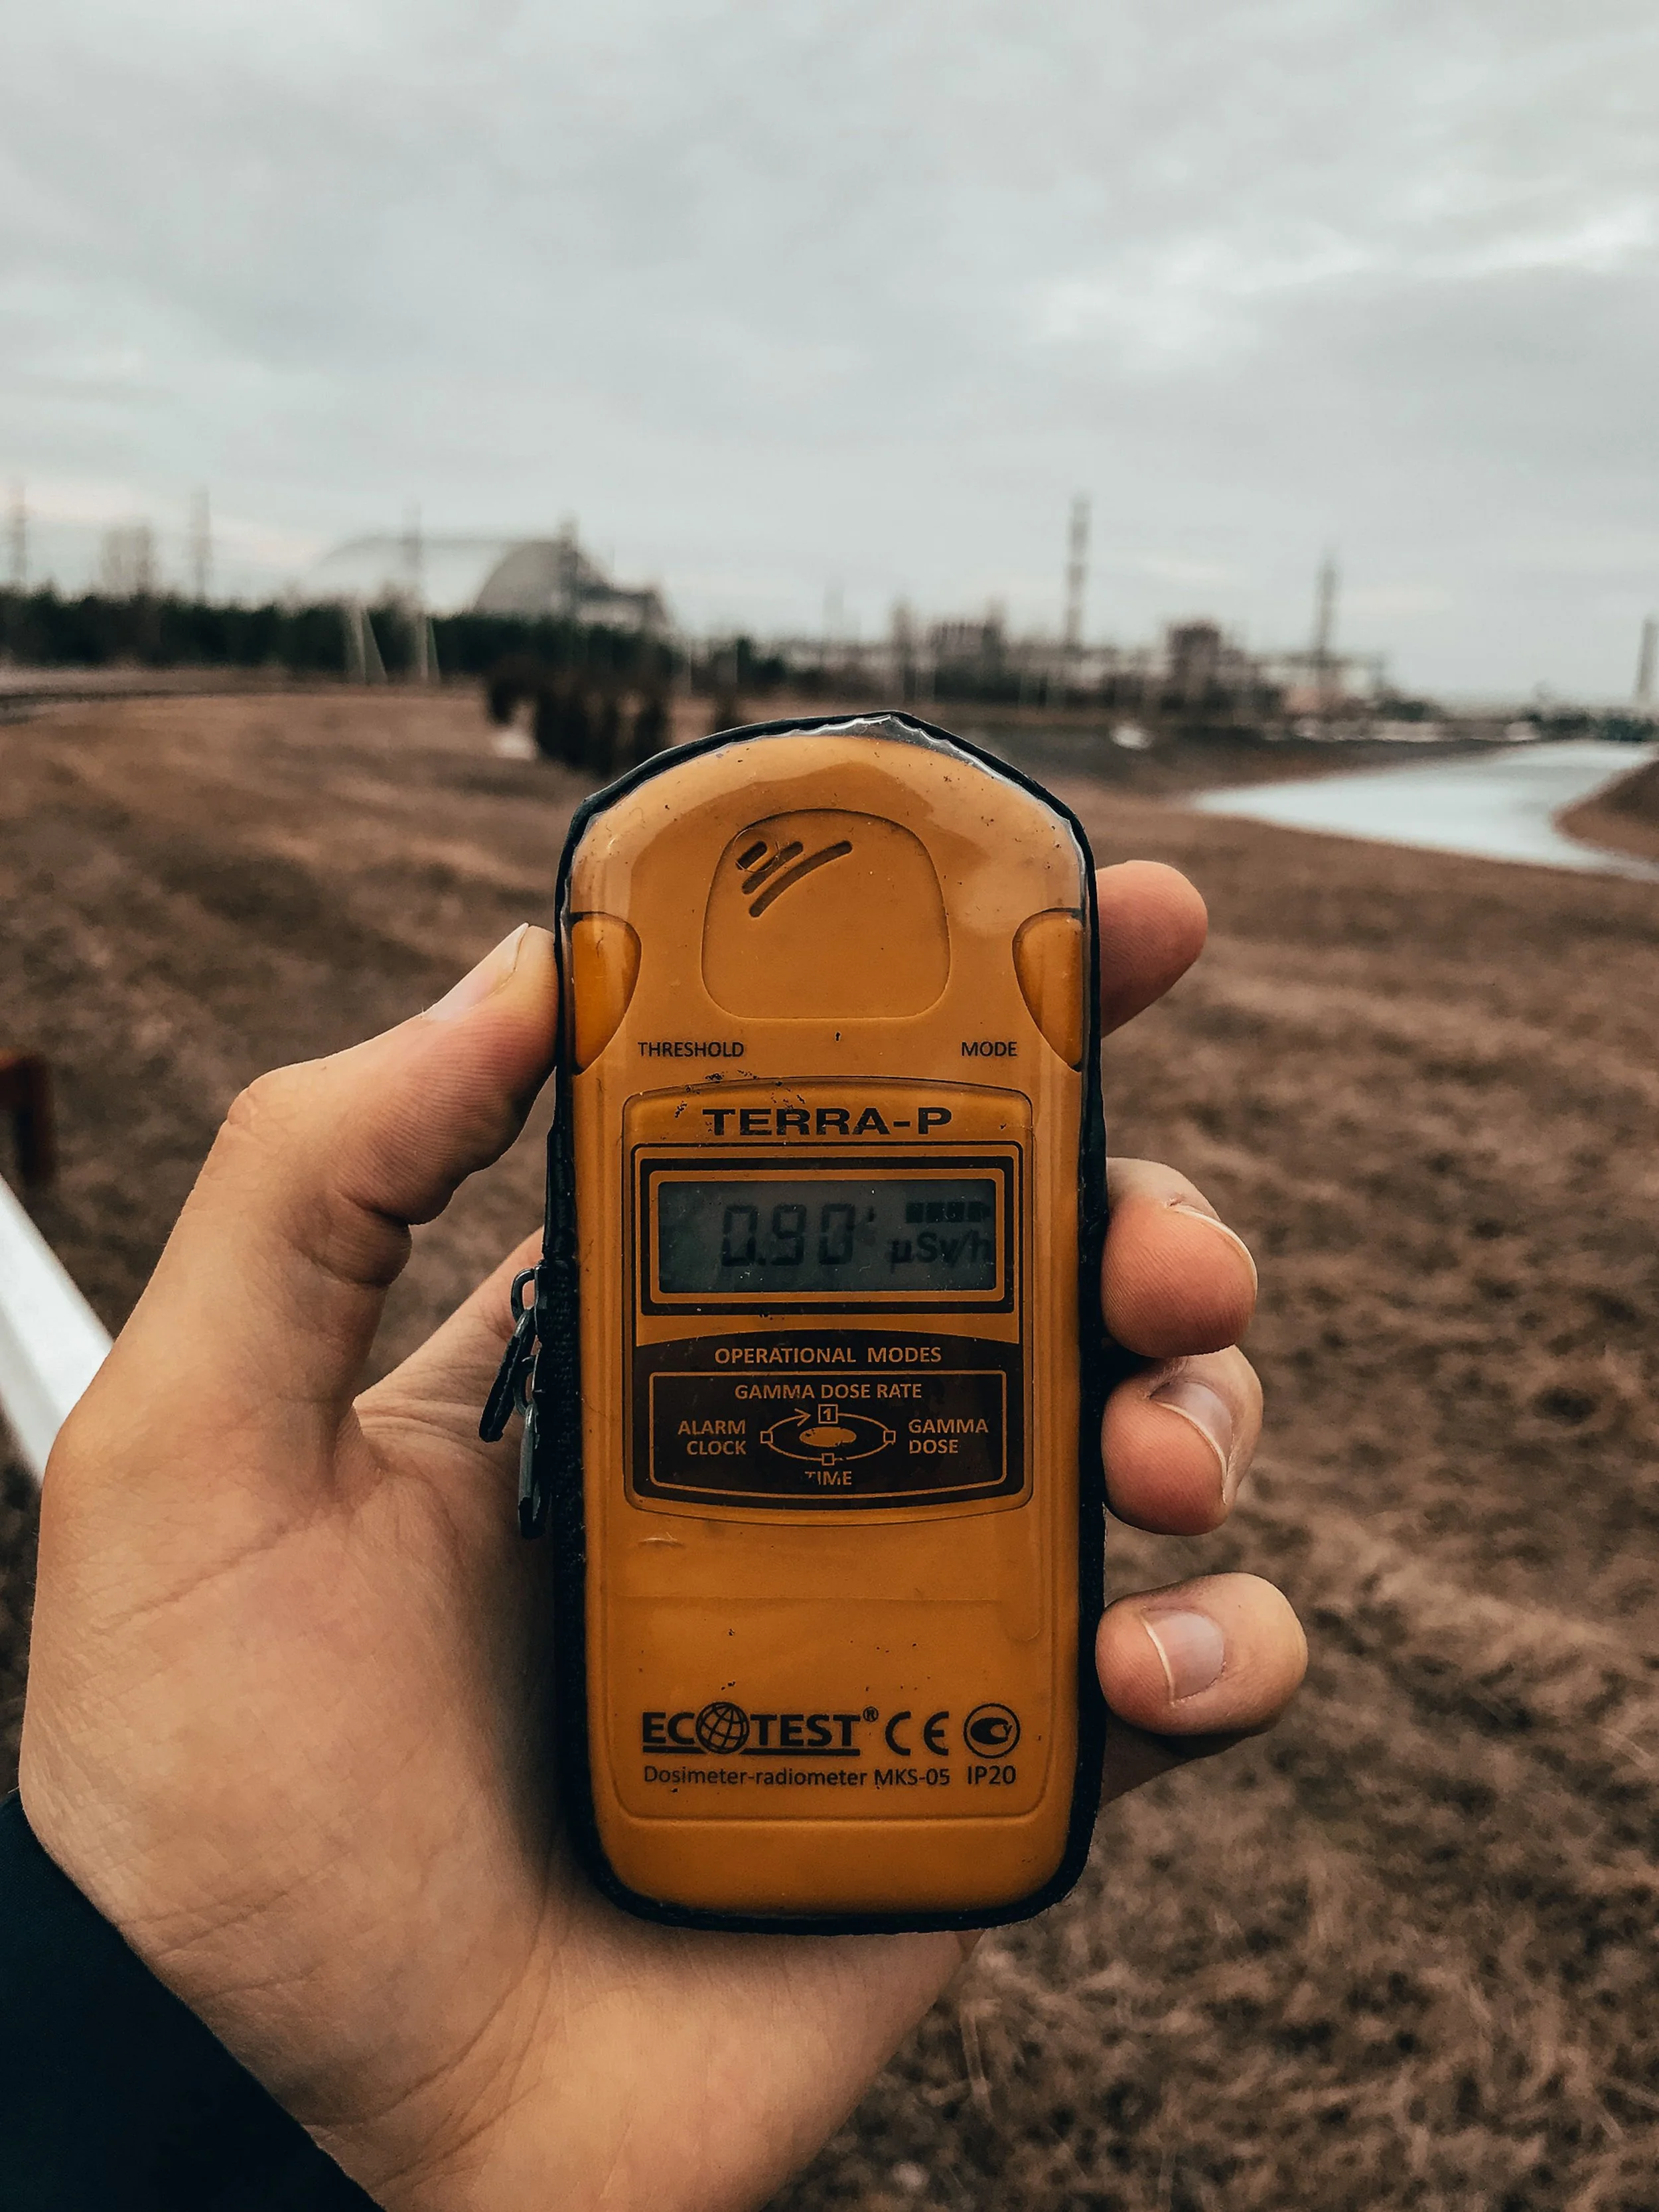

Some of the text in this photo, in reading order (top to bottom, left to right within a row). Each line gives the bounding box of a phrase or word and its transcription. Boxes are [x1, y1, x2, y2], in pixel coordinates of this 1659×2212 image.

[638, 1041, 745, 1058] THRESHOLD
[961, 1041, 1018, 1057] MODE
[702, 1107, 952, 1136] TERRA-P
[721, 1203, 856, 1267] 0.90
[715, 1347, 942, 1364] OPERATIONAL MODES
[735, 1384, 922, 1400] GAMMA DOSE RATE
[823, 1408, 831, 1420] 1
[678, 1420, 747, 1436] ALARM
[908, 1419, 989, 1434] GAMMA
[686, 1439, 747, 1456] CLOCK
[909, 1439, 959, 1455] DOSE
[804, 1471, 852, 1486] TIME
[885, 1710, 950, 1757] CE
[644, 1766, 950, 1787] Dosimeter-radiometer MKS-05
[967, 1766, 1017, 1785] IP20
